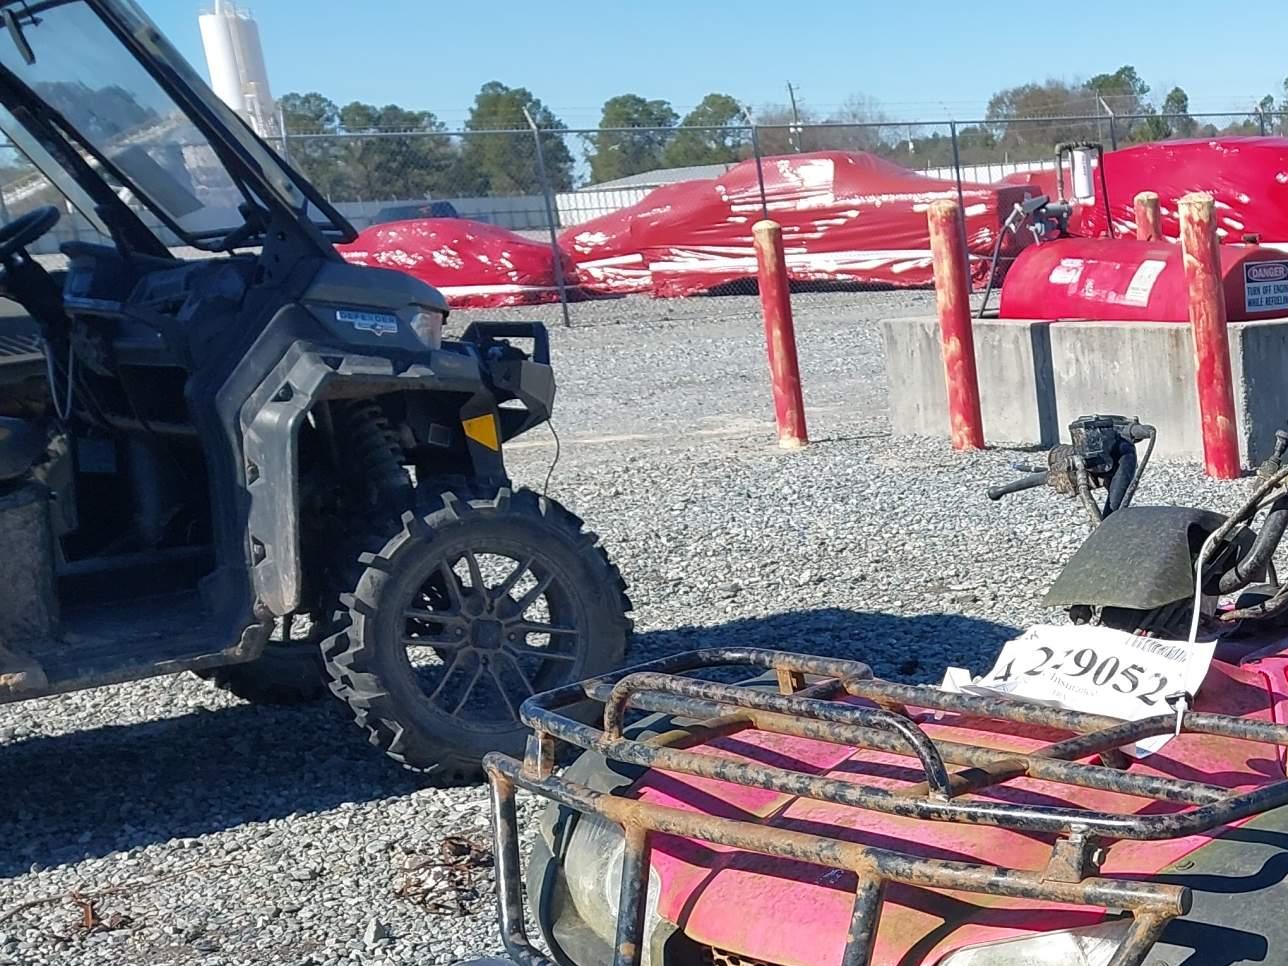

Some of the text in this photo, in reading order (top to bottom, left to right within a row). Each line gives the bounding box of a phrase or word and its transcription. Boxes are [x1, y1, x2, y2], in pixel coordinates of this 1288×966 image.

[1252, 266, 1285, 278] DANGER
[1247, 286, 1261, 296] TURN
[1262, 284, 1272, 295] OFF
[1247, 296, 1264, 307] WHILE
[340, 311, 395, 323] DEFENDER
